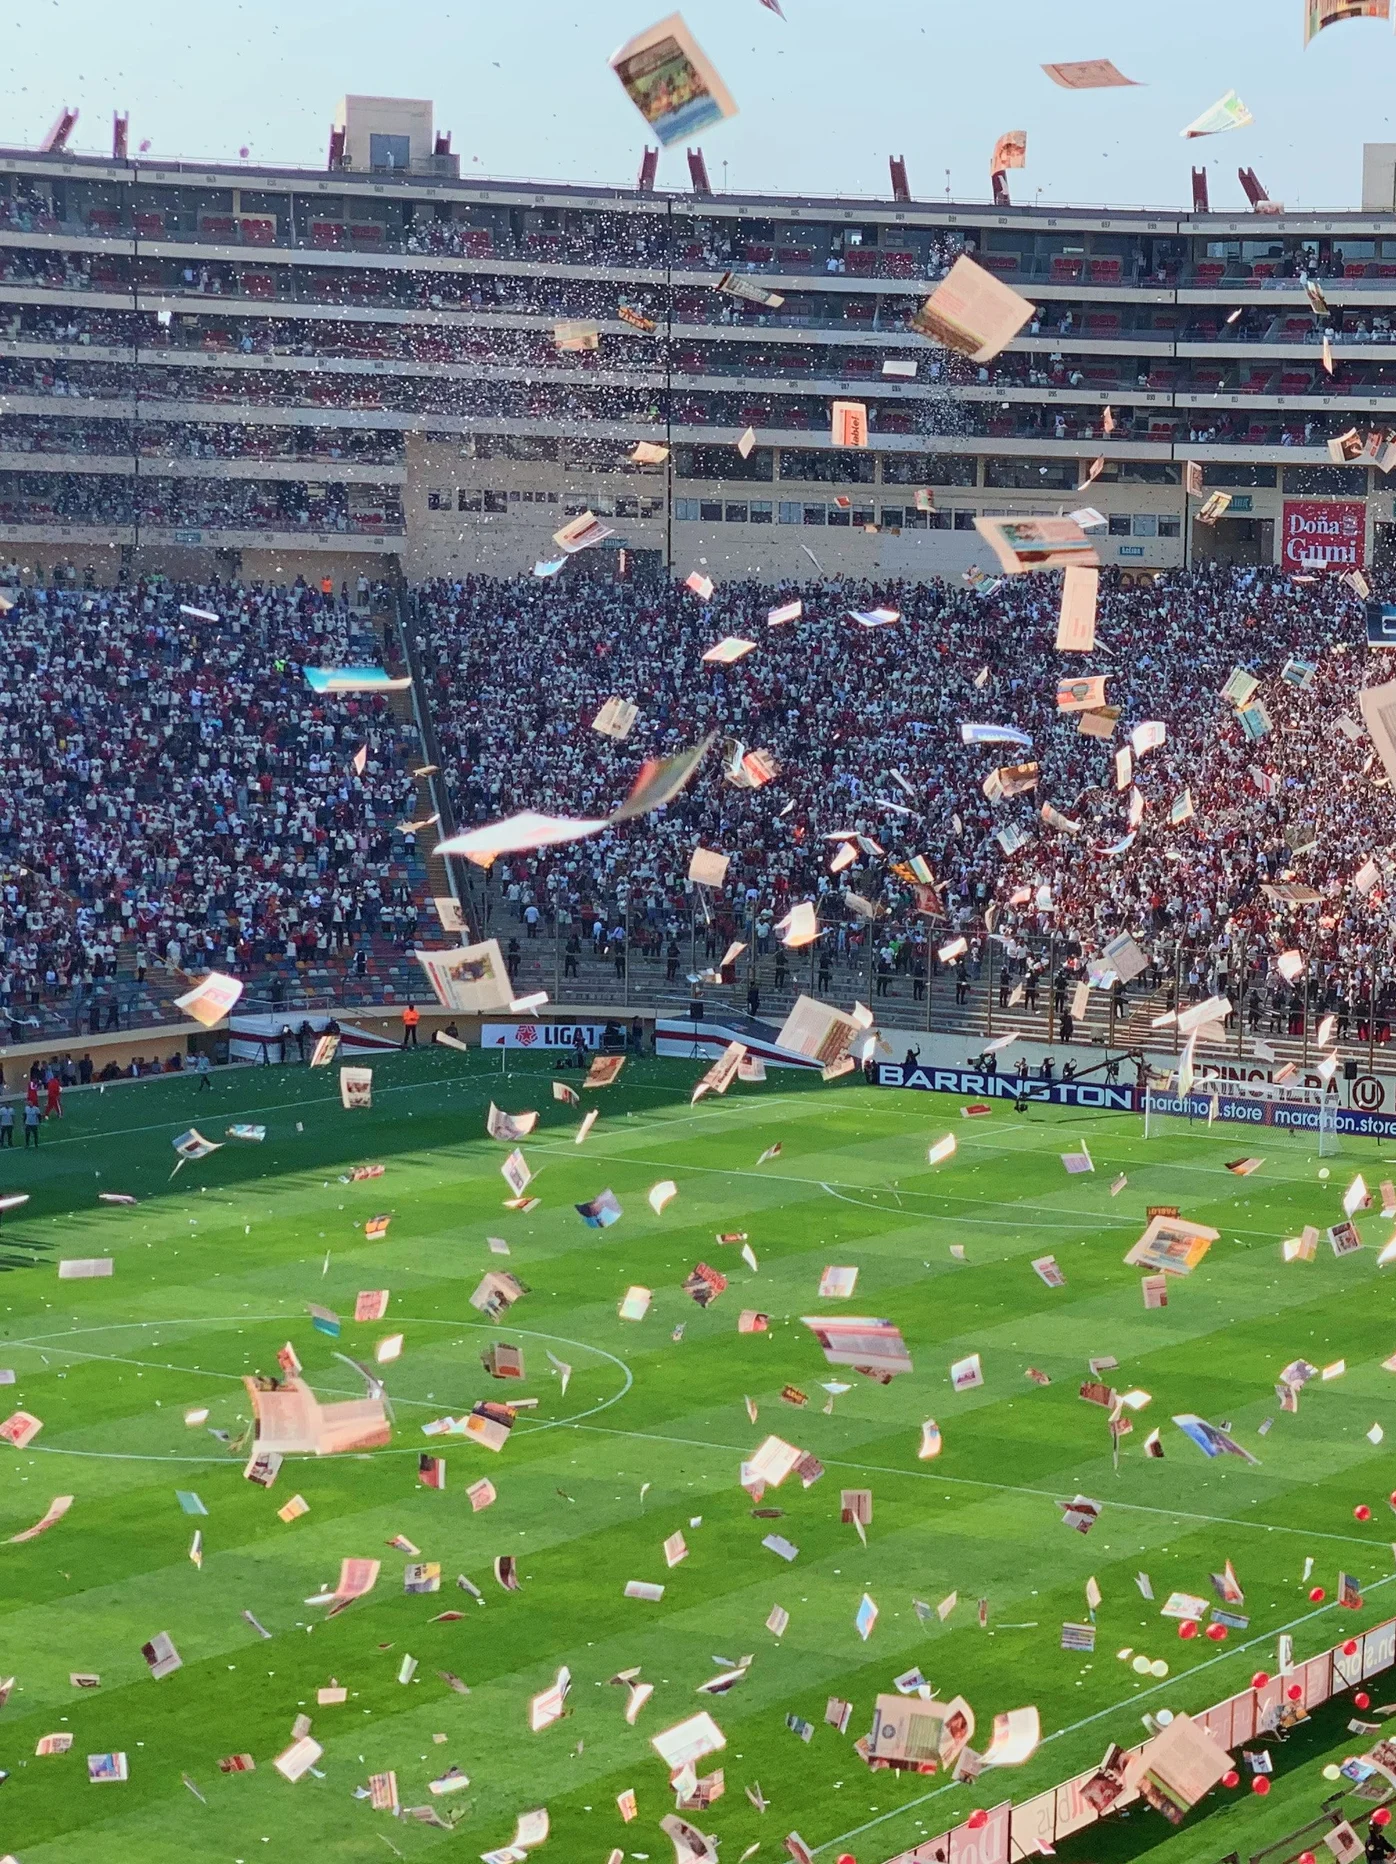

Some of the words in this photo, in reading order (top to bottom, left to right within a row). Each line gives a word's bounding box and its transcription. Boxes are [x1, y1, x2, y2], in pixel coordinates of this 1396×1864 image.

[1289, 513, 1340, 536] Doña
[1287, 537, 1356, 564] Gumi
[879, 1065, 1132, 1110] BARRINGTON
[1192, 1063, 1342, 1107] TRINCHRA
[1141, 1093, 1263, 1121] maratho.store
